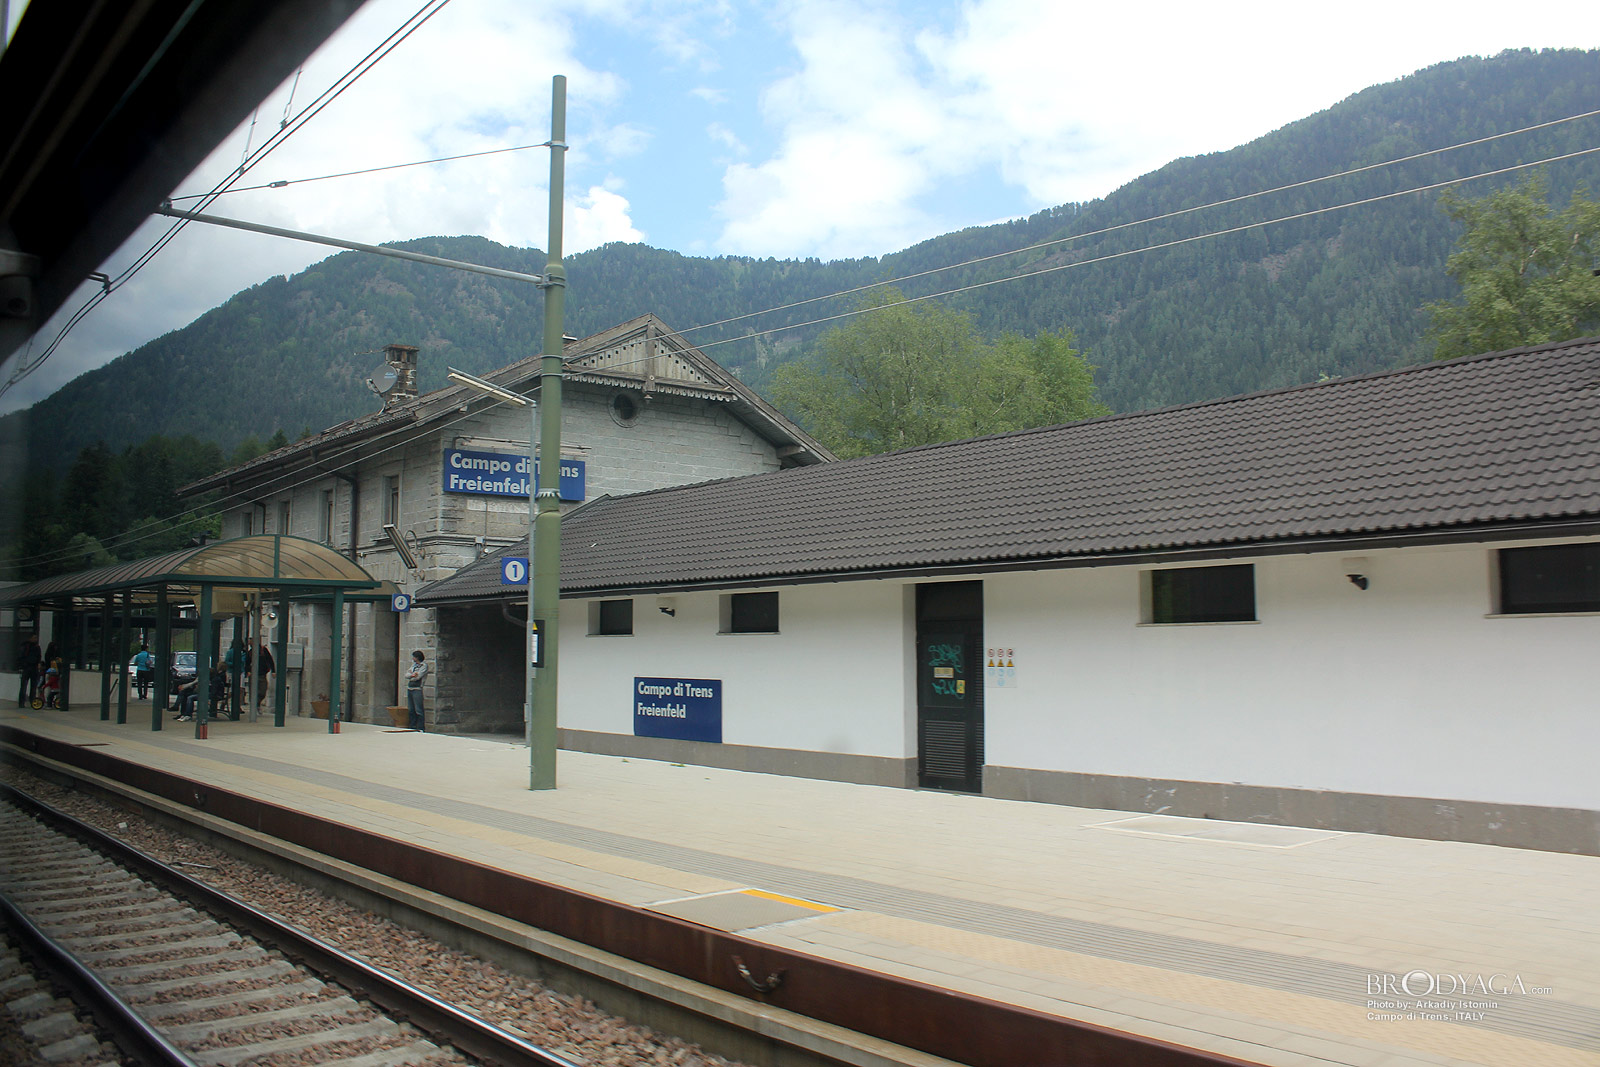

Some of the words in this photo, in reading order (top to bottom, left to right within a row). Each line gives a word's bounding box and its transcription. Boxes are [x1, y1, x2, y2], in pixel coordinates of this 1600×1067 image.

[450, 453, 511, 475] Campo
[515, 457, 531, 474] di
[512, 565, 518, 578] 1
[638, 682, 671, 698] Campo
[673, 682, 684, 697] di
[685, 684, 713, 698] Trens
[637, 702, 686, 718] Freienfeld
